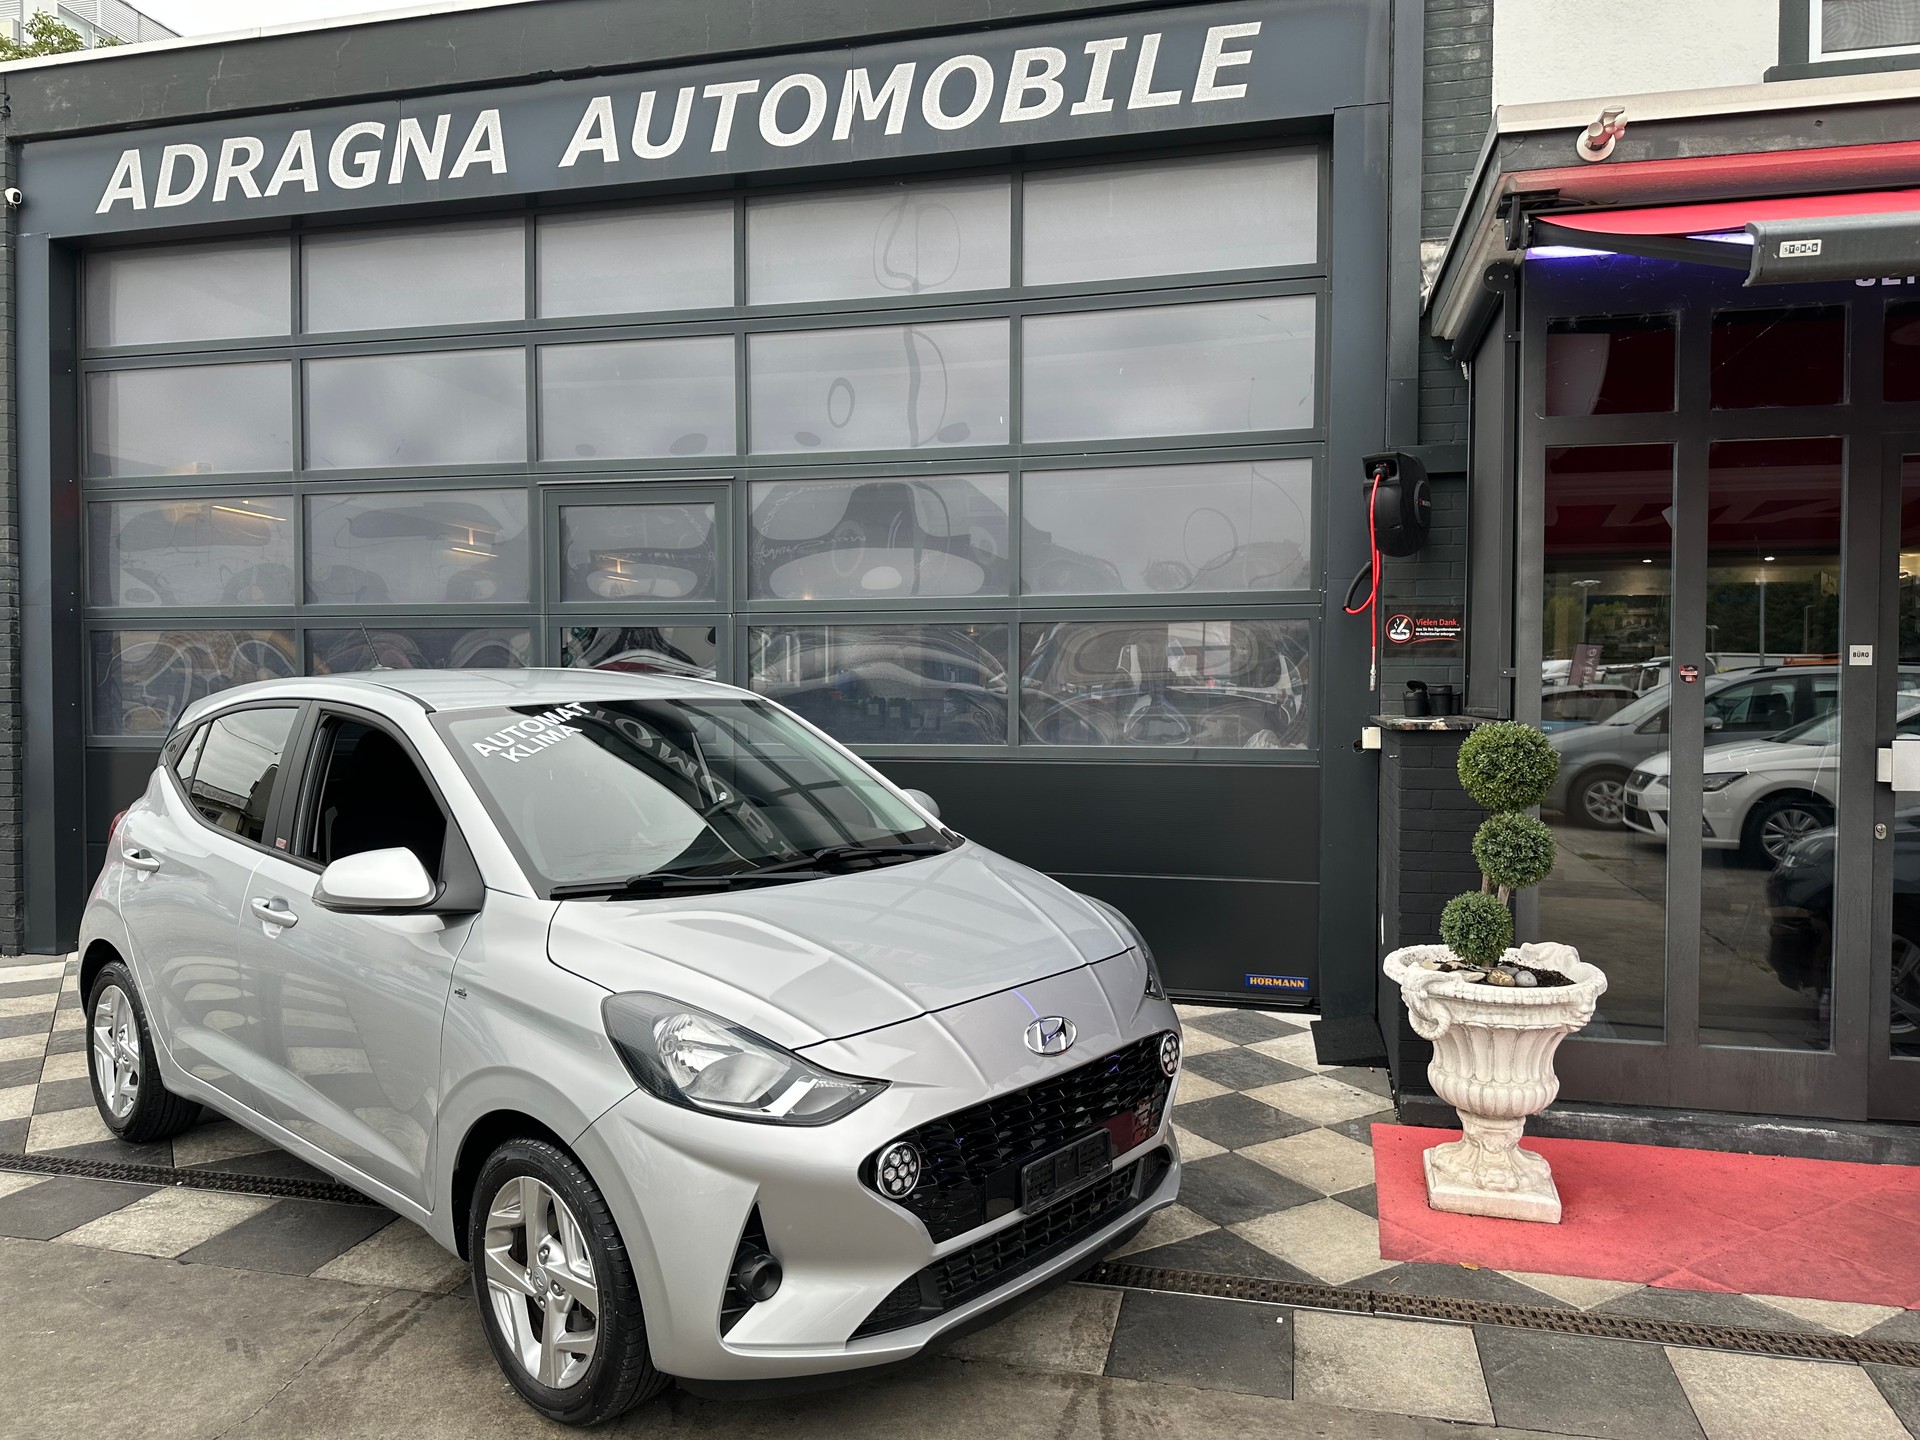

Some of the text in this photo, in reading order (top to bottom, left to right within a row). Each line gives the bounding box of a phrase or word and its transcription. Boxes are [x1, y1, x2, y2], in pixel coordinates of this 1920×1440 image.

[95, 21, 1262, 215] ADRAGNA AUTOMOBILE
[1415, 618, 1438, 626] Vielen
[472, 701, 591, 758] AUTOMAT
[499, 722, 583, 763] KLIMA
